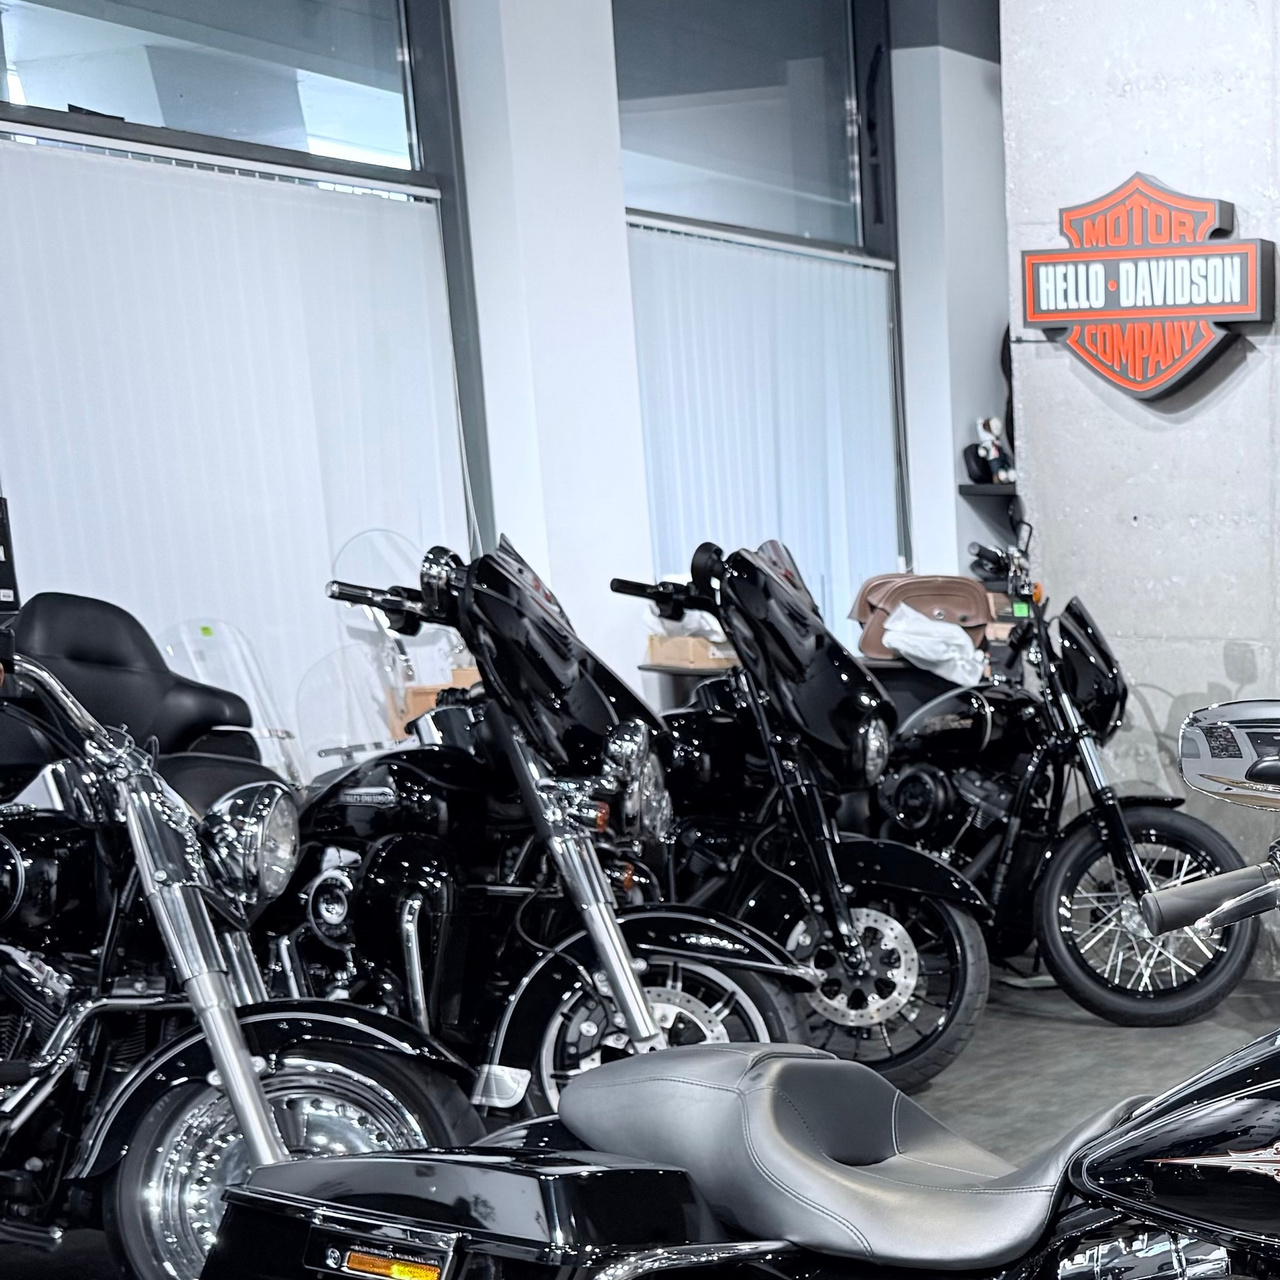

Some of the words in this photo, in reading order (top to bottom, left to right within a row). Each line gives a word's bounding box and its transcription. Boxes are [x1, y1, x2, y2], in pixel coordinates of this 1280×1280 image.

[1082, 194, 1195, 248] MOTOR
[1038, 263, 1106, 310] HELLO
[1118, 256, 1241, 307] DAVIDSON
[1084, 320, 1197, 380] COMPANY
